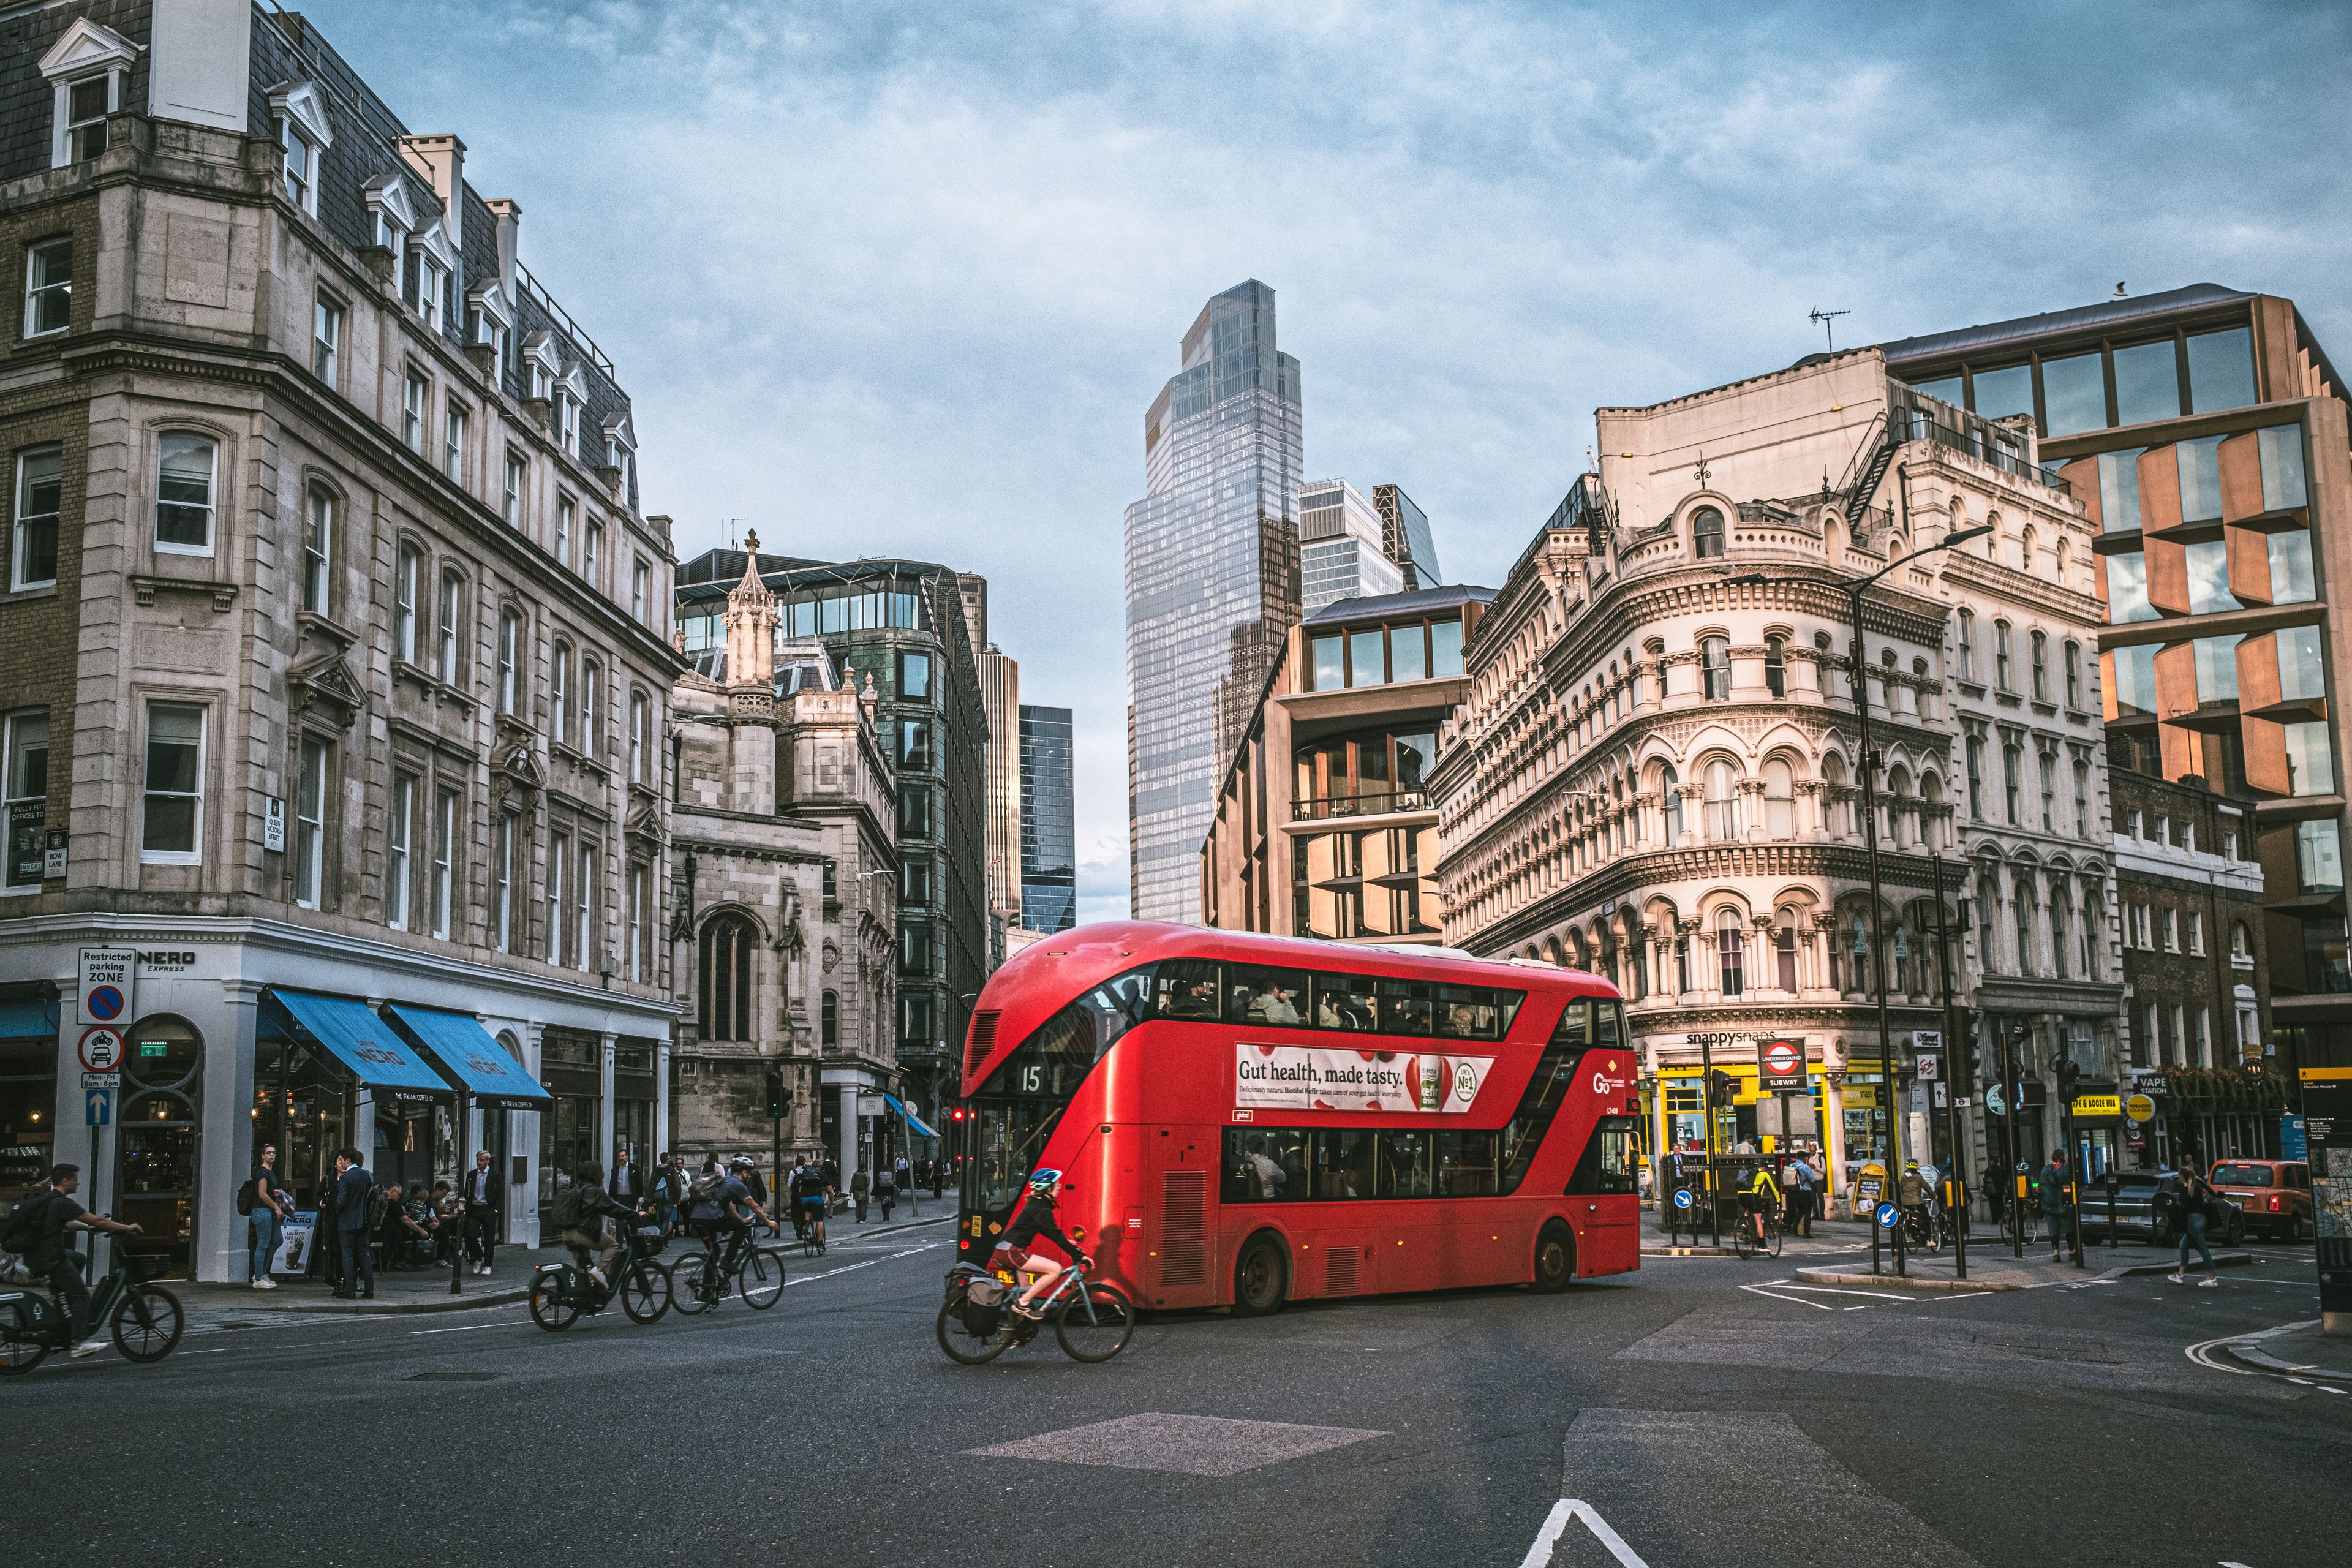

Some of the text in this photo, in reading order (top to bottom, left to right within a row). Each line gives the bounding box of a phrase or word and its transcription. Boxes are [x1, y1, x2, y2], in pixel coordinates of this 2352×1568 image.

[267, 825, 282, 834] VICTORIA
[84, 952, 132, 961] Restricted
[137, 951, 195, 964] NERO
[89, 973, 124, 982] ZONE
[1023, 1066, 1041, 1091] 15
[1239, 1060, 1267, 1080] Gut
[1270, 1061, 1321, 1085] health,
[1325, 1065, 1363, 1084] made
[1366, 1068, 1403, 1088] tasty.
[1593, 1072, 1610, 1095] Go
[2140, 1078, 2166, 1087] VAPE
[2083, 1099, 2087, 1108] &
[2089, 1099, 2105, 1108] BOOZE
[2106, 1099, 2116, 1107] HUB
